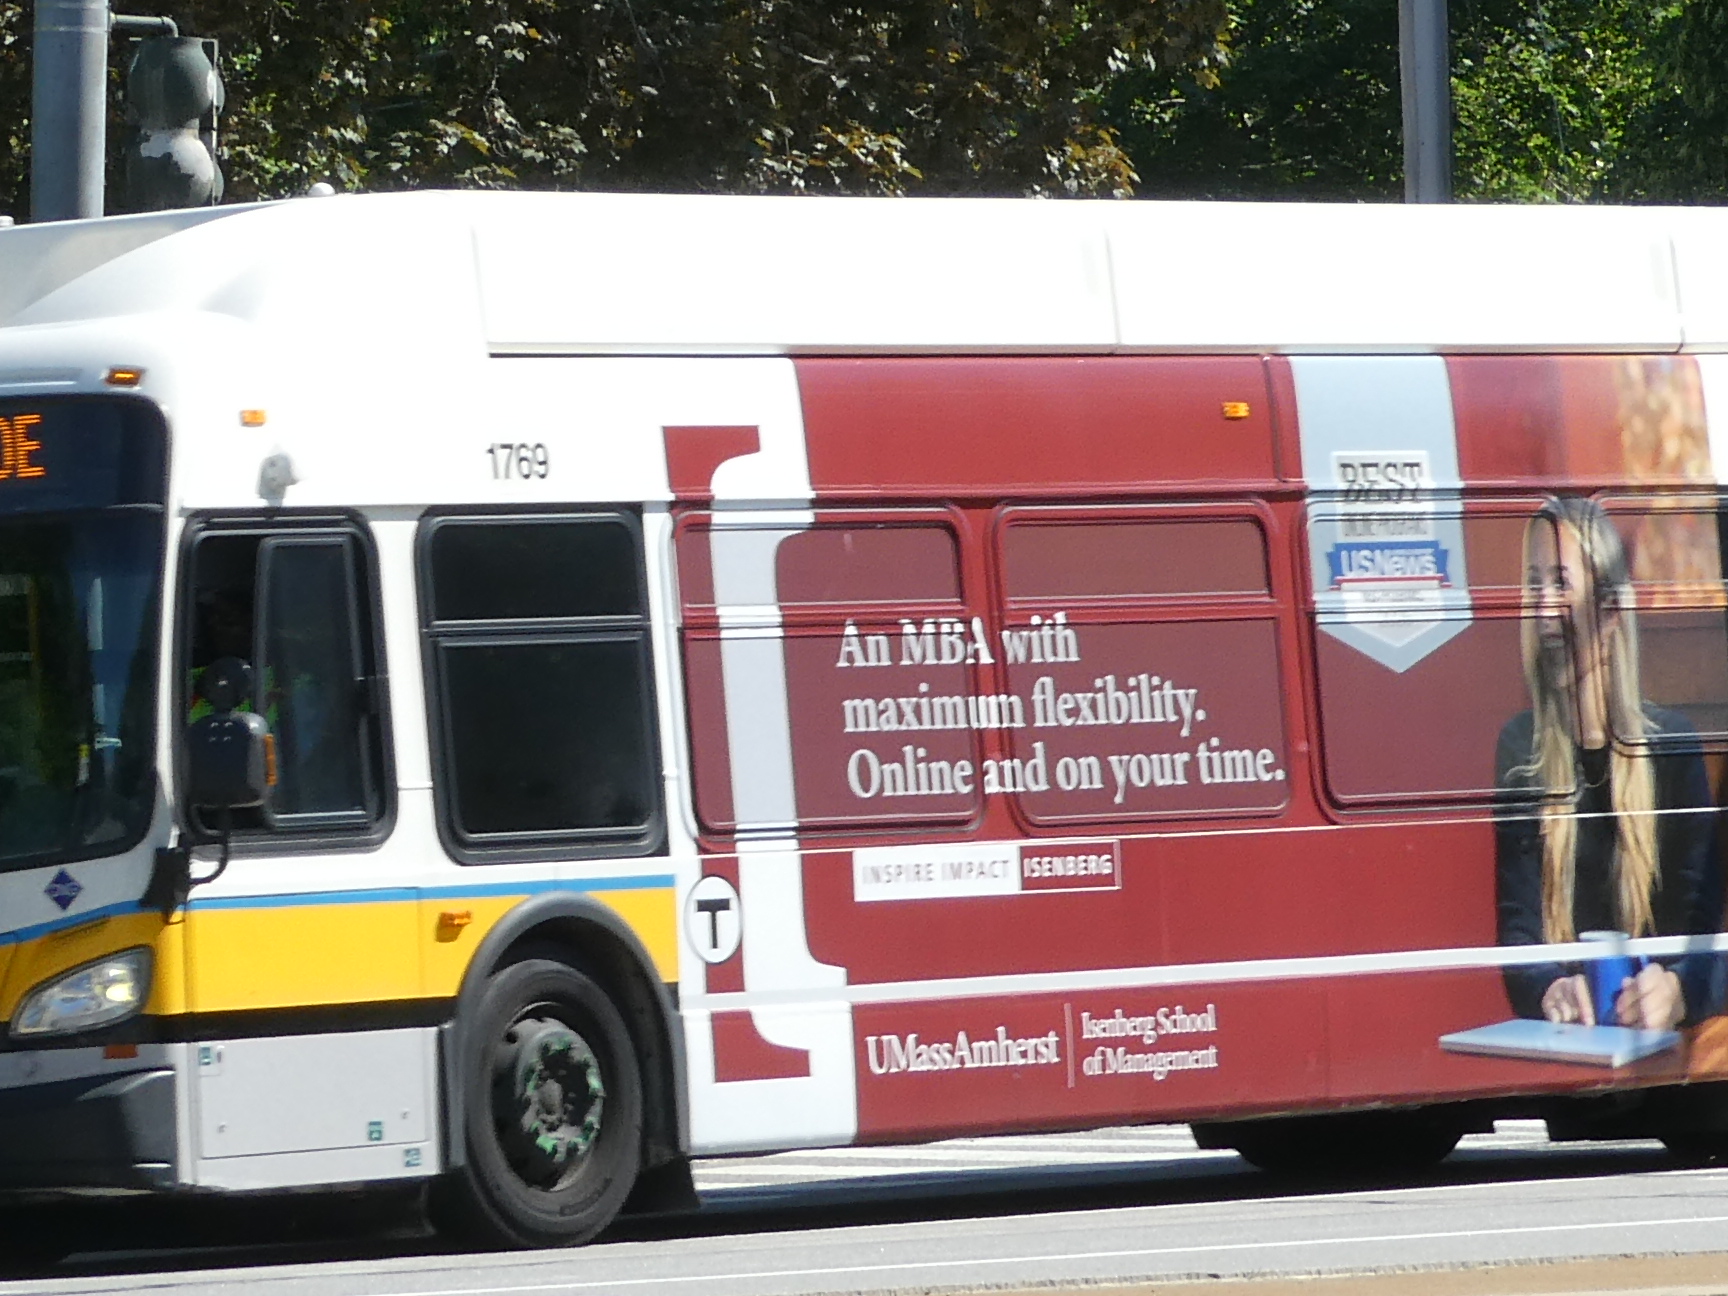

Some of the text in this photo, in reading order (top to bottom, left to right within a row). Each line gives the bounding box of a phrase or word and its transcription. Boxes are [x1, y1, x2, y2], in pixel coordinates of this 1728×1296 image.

[486, 442, 550, 480] 1769
[1339, 462, 1422, 504] BEST
[836, 611, 1081, 668] An MBA with
[842, 674, 1207, 737] maximum flexibility.
[847, 737, 1287, 804] Online and on your time.
[862, 859, 1010, 885] INSPIRE IMPACT
[1023, 854, 1114, 878] ISENBERG
[694, 898, 732, 950] T
[1081, 1003, 1217, 1045] Isenberg School
[1082, 1044, 1219, 1081] of Management
